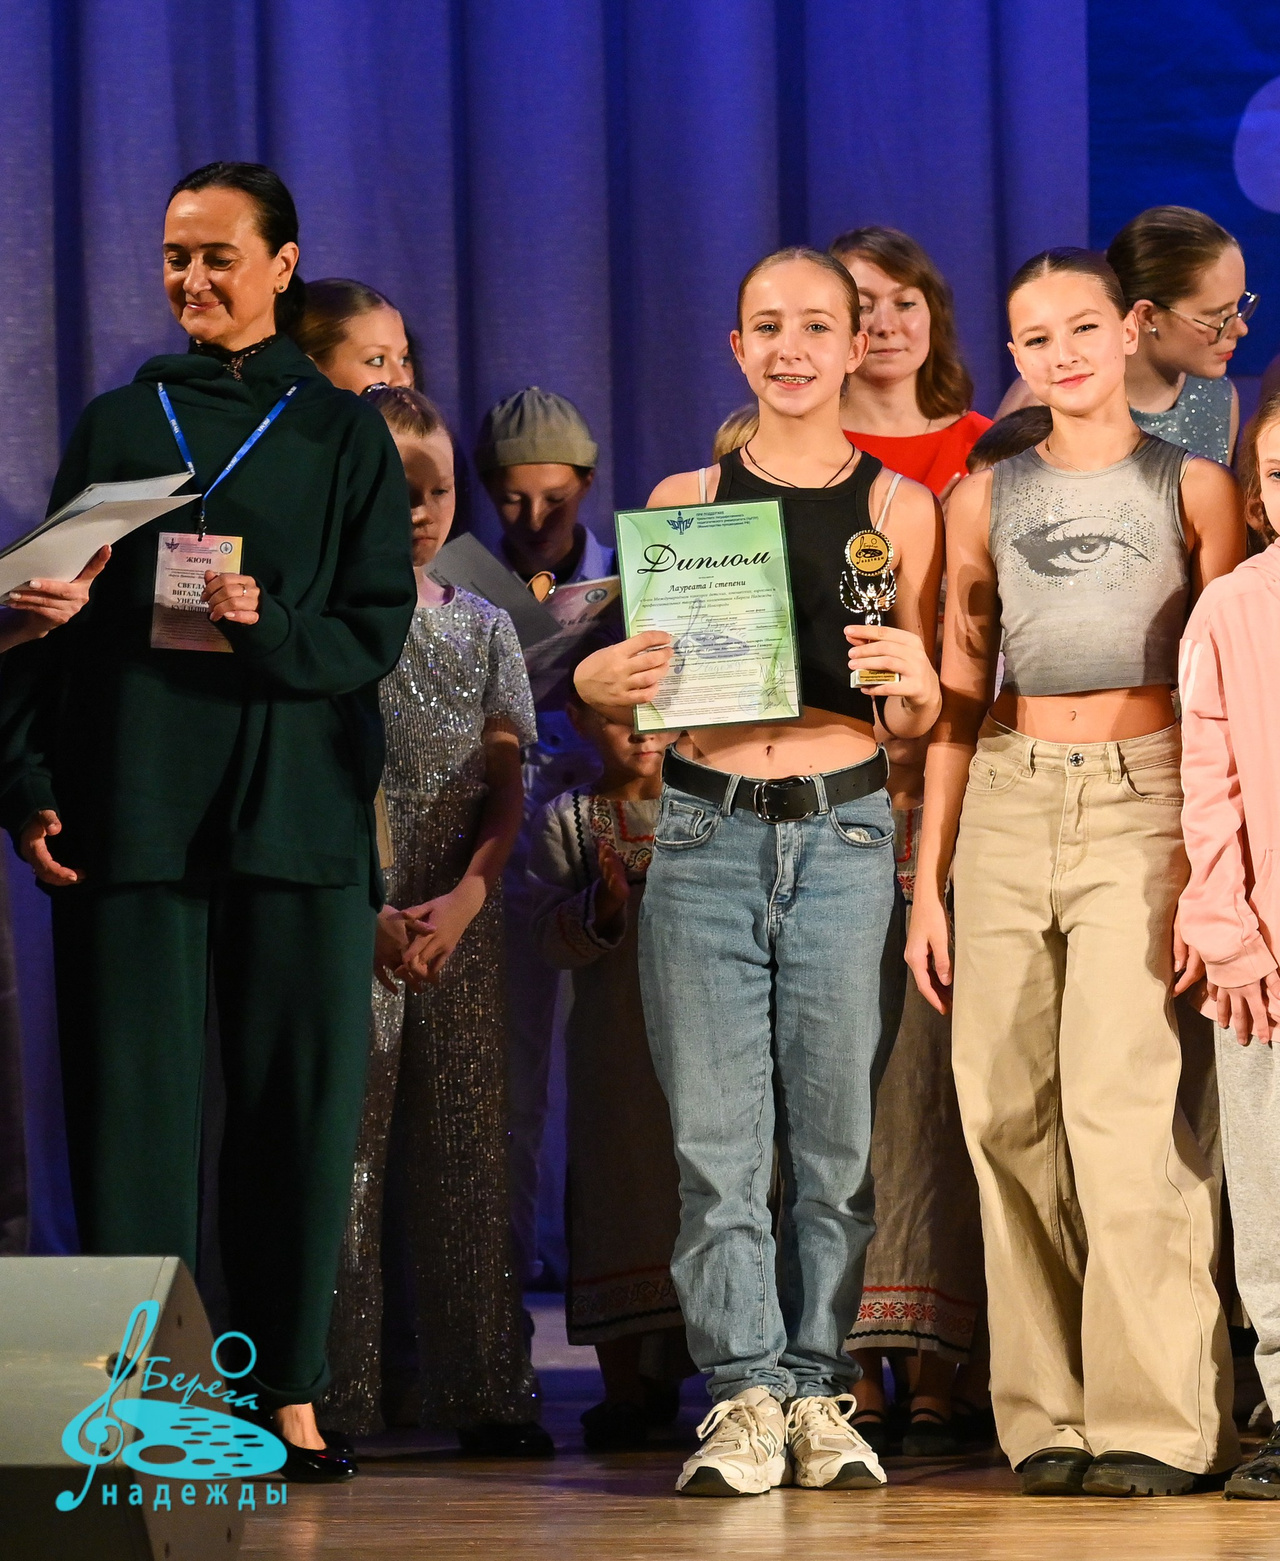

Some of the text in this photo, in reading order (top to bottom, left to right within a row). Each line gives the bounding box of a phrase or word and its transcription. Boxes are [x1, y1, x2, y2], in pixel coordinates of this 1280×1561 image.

[186, 556, 212, 565] ЖЮРИ
[637, 543, 771, 574] Диплом
[177, 582, 207, 590] СВЕТЛА
[667, 583, 707, 594] Лауреата
[714, 580, 746, 588] степени
[172, 589, 201, 597] ВИТАЛЬ
